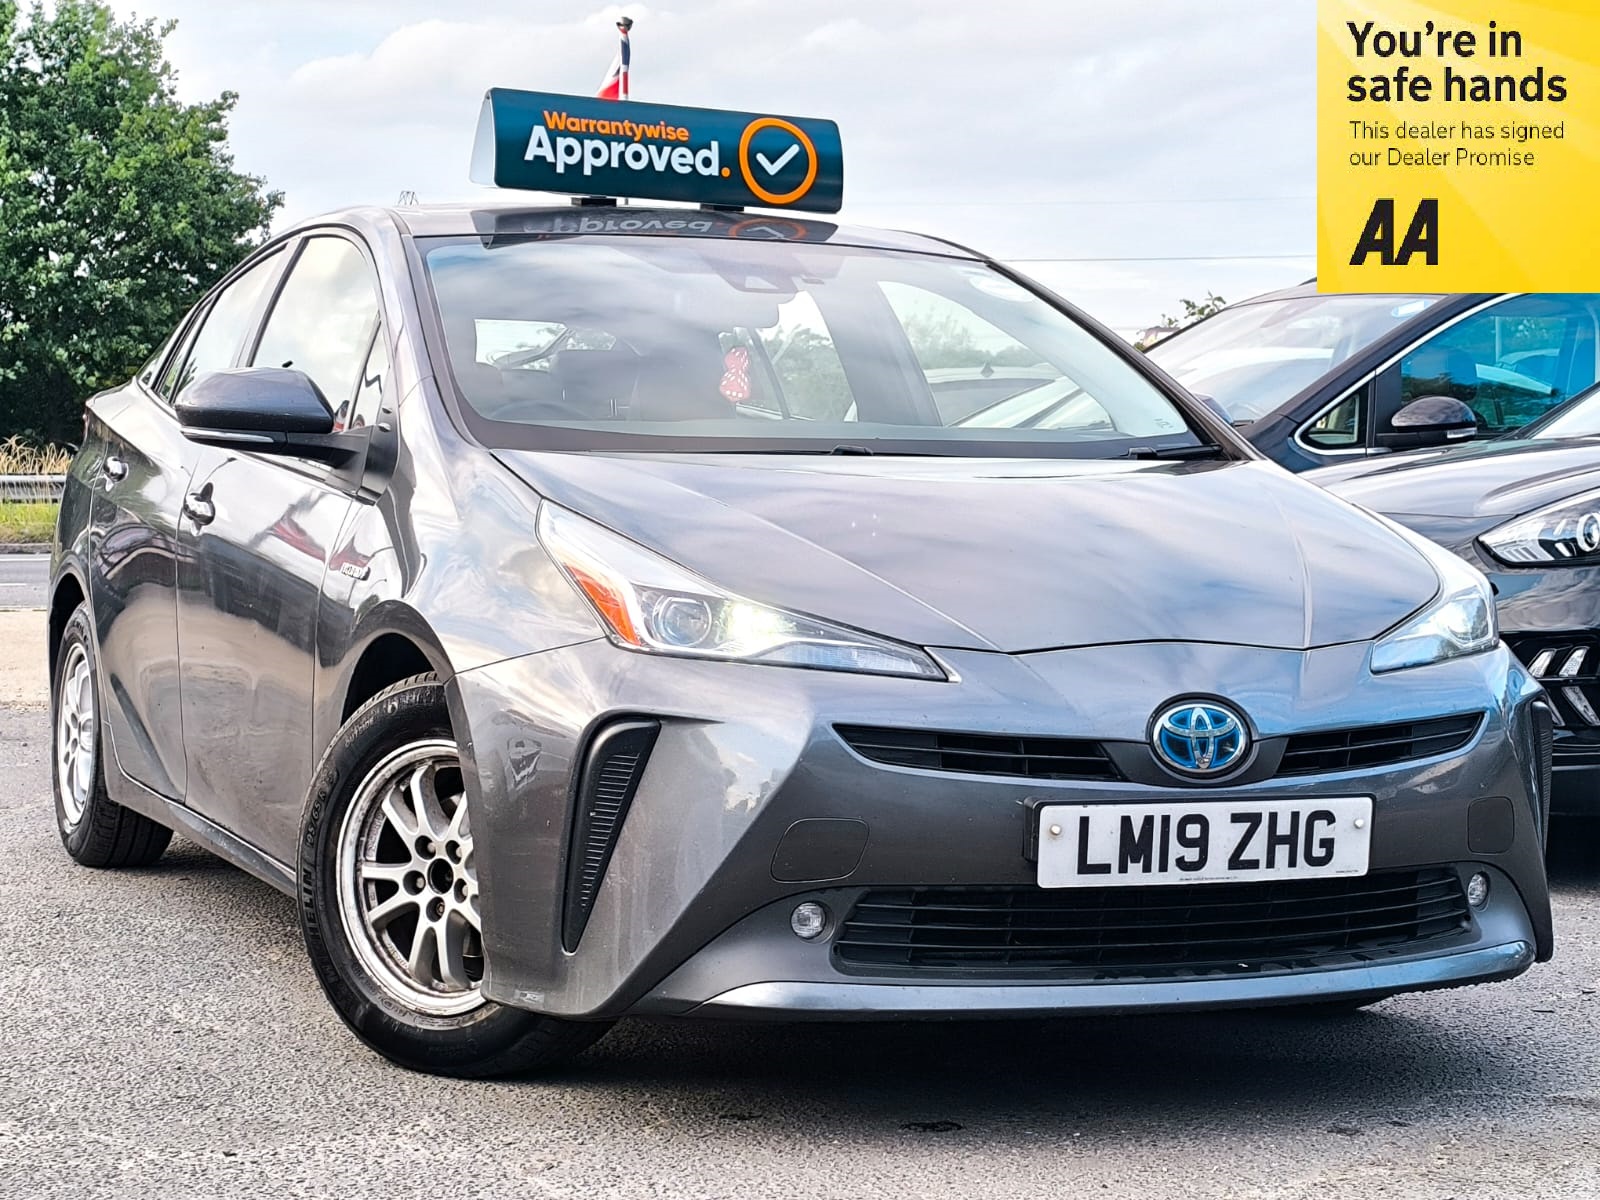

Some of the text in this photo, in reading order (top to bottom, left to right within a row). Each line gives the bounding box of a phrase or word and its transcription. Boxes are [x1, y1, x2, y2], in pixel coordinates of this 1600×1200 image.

[524, 125, 731, 178] Approved.
[543, 110, 689, 142] Warrantywise
[1077, 809, 1336, 875] LM19 ZHG
